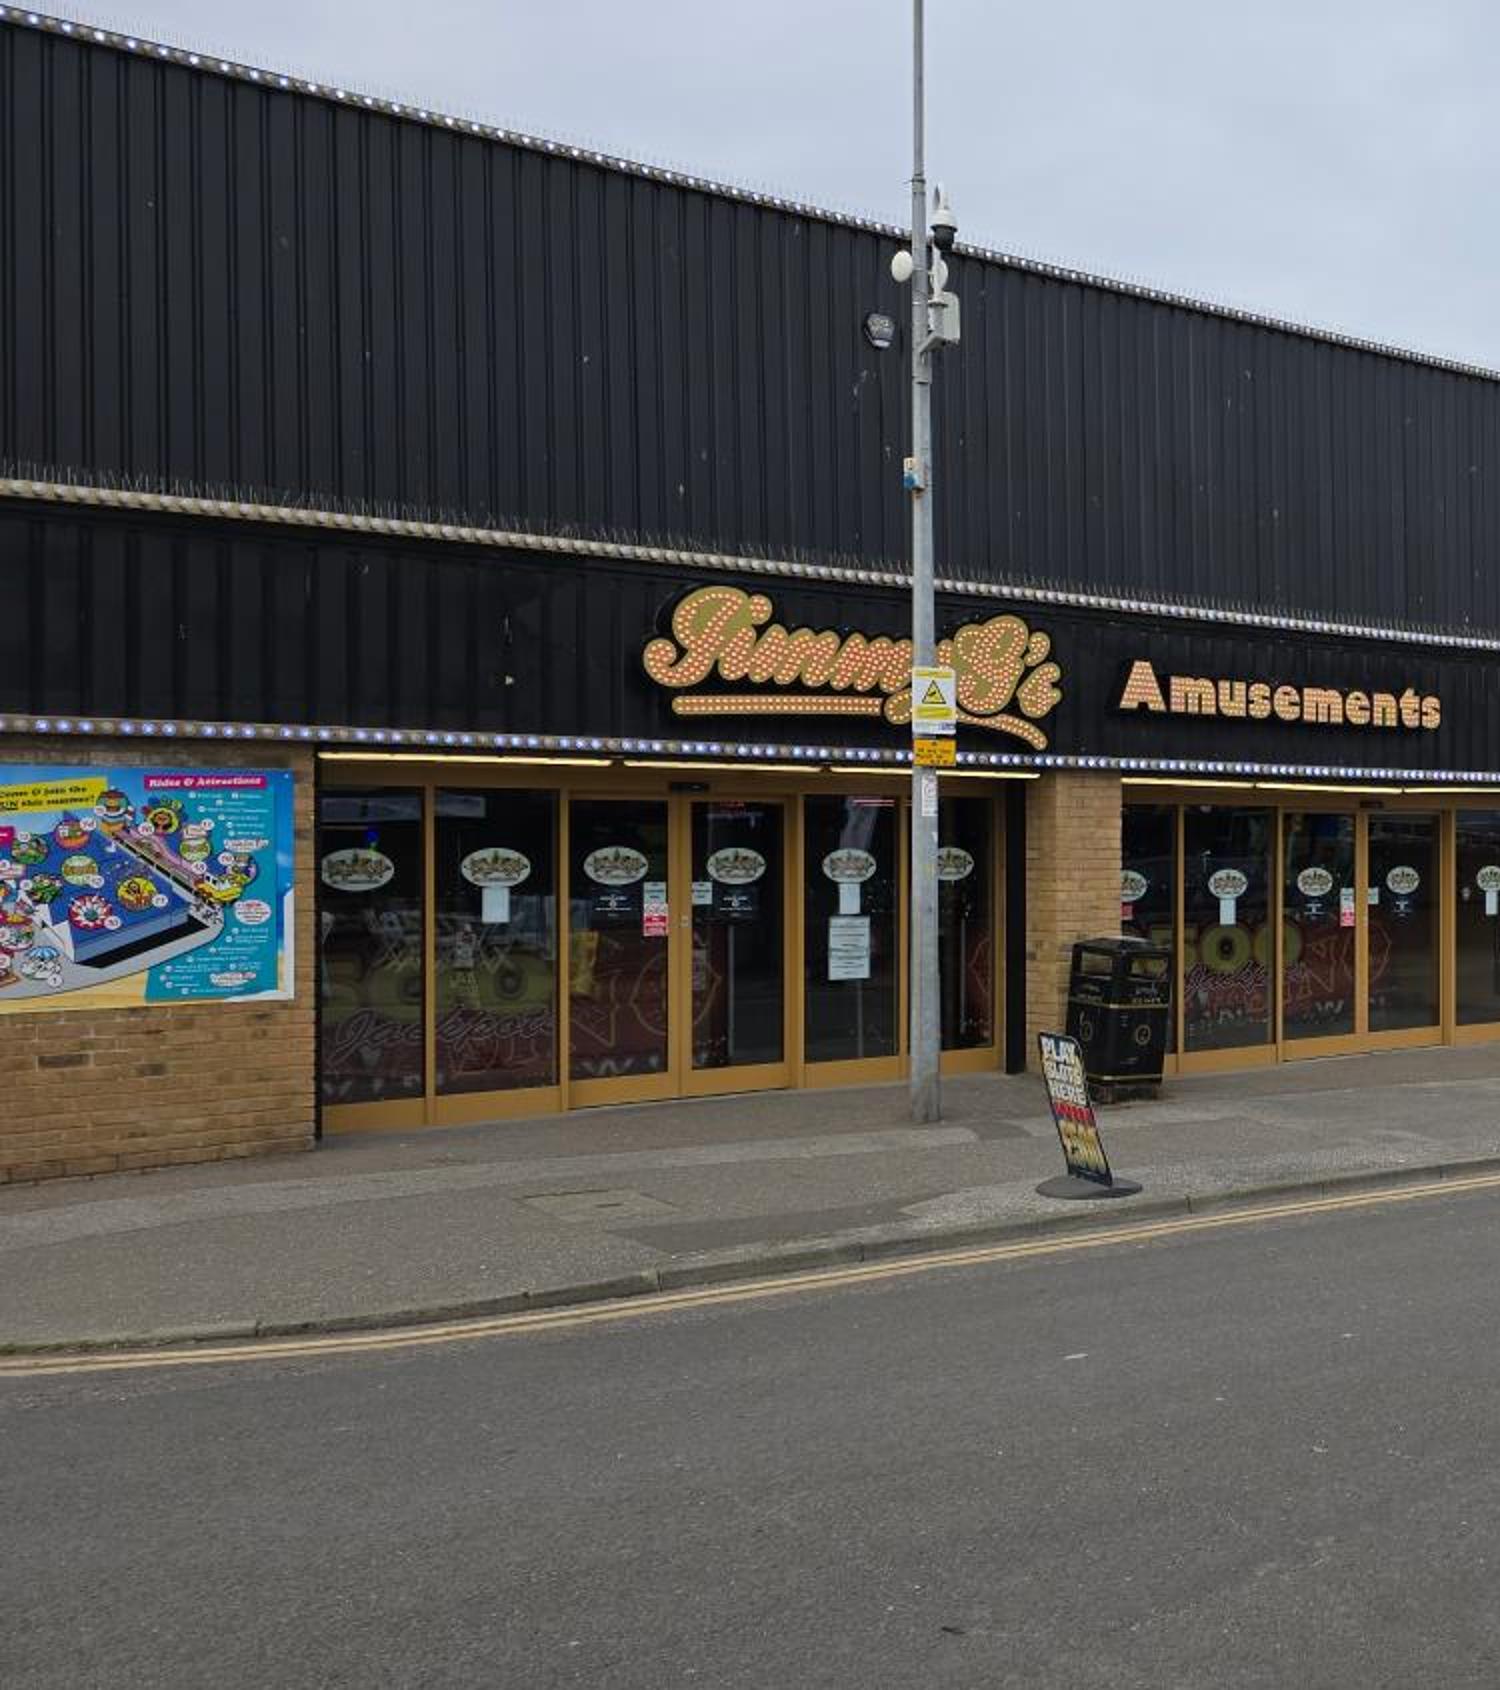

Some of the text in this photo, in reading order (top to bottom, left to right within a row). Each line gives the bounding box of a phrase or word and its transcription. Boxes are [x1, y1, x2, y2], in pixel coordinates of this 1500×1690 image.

[1119, 660, 1441, 730] Amusements
[149, 779, 181, 788] Rides
[1041, 1036, 1077, 1066] PLAY
